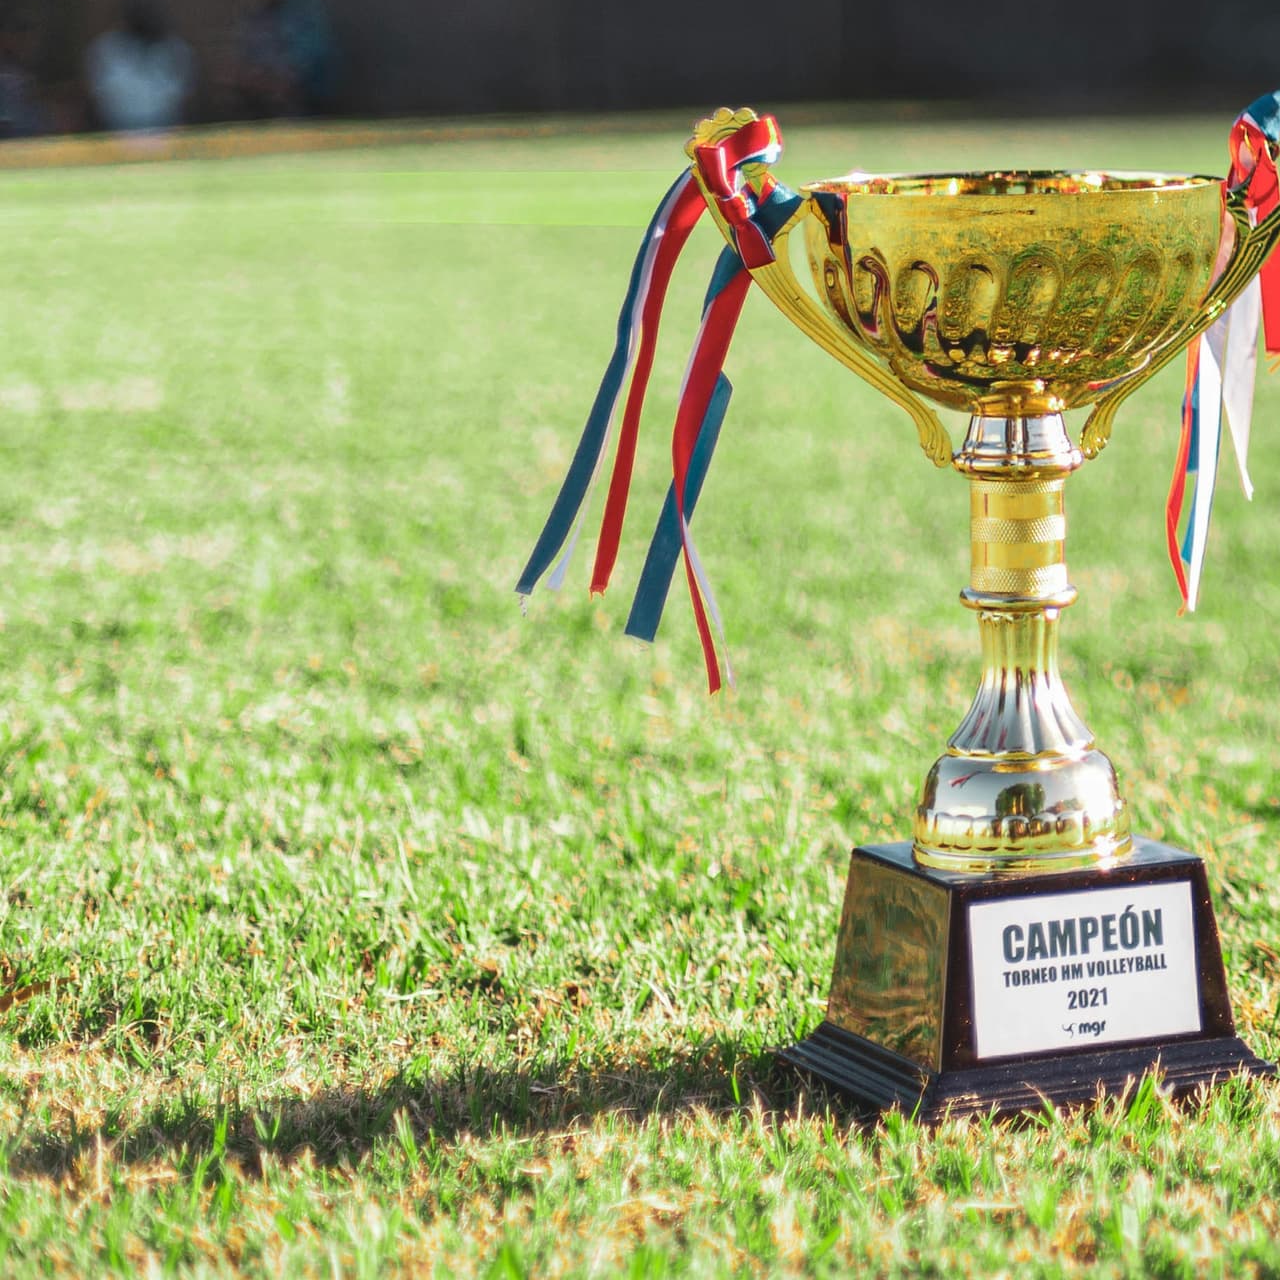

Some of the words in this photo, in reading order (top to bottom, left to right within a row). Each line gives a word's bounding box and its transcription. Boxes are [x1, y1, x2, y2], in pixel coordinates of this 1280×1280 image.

[1002, 904, 1164, 963] CAMPEÓN
[1002, 965, 1057, 988] TORNEO
[1061, 962, 1084, 981] HM
[1086, 953, 1168, 977] VOLLEYBALL
[1066, 987, 1109, 1010] 2021
[1077, 1020, 1107, 1038] mgr
